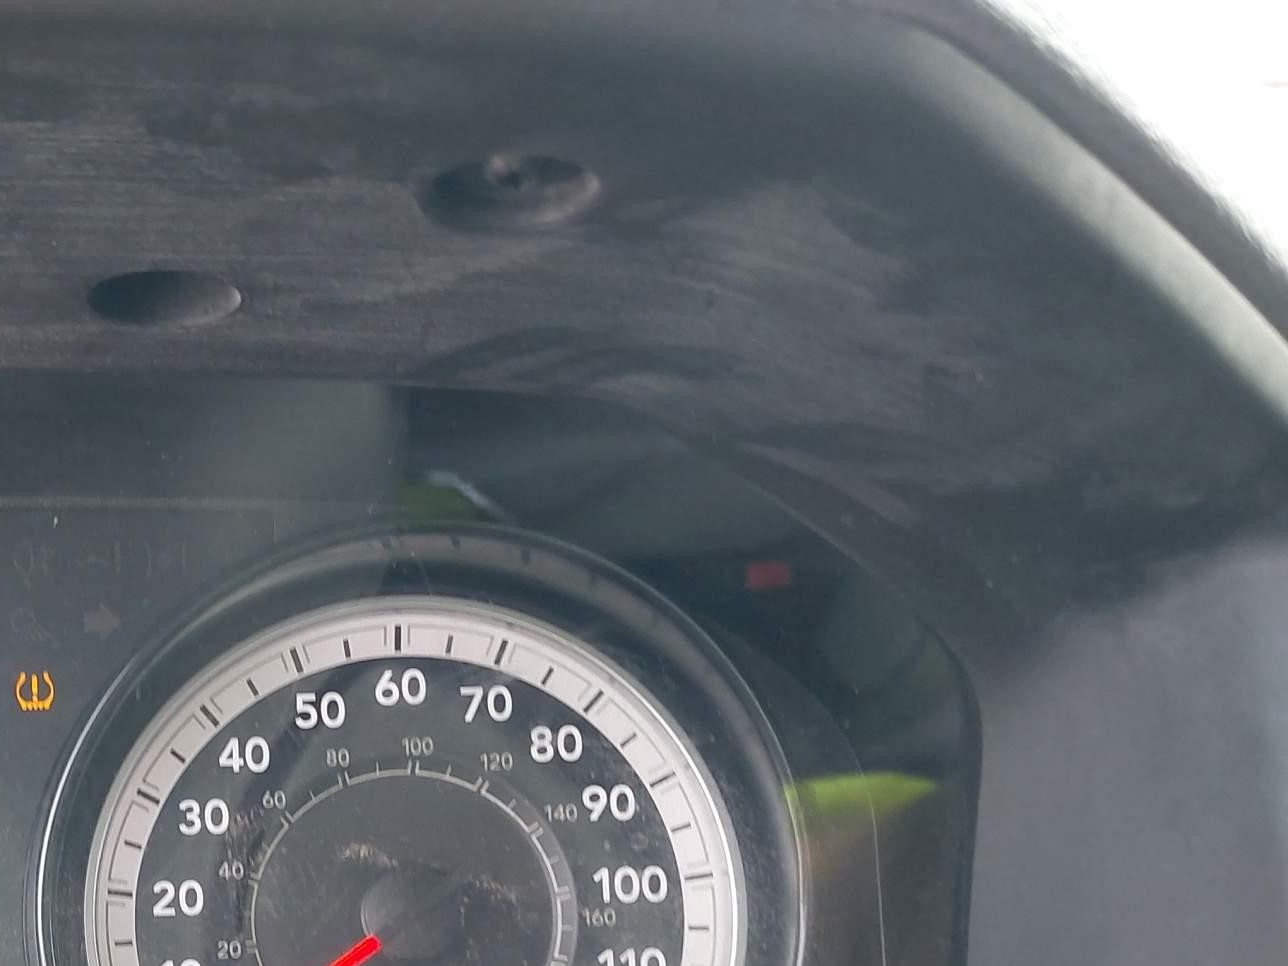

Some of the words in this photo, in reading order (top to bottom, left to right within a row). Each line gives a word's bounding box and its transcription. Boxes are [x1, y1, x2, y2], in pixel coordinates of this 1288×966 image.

[374, 667, 427, 706] 60
[460, 685, 513, 723] 70
[295, 691, 347, 729] 50
[218, 735, 271, 774] 40
[325, 747, 351, 768] 80
[400, 736, 434, 757] 100
[479, 751, 514, 773] 120
[529, 724, 584, 764] 80
[178, 797, 230, 836] 30
[261, 789, 287, 809] 60
[543, 803, 578, 823] 140
[581, 783, 636, 823] 90
[218, 860, 245, 881] 40
[592, 864, 668, 904] 100
[152, 879, 205, 917] 20
[581, 906, 616, 928] 160
[216, 939, 242, 961] 20
